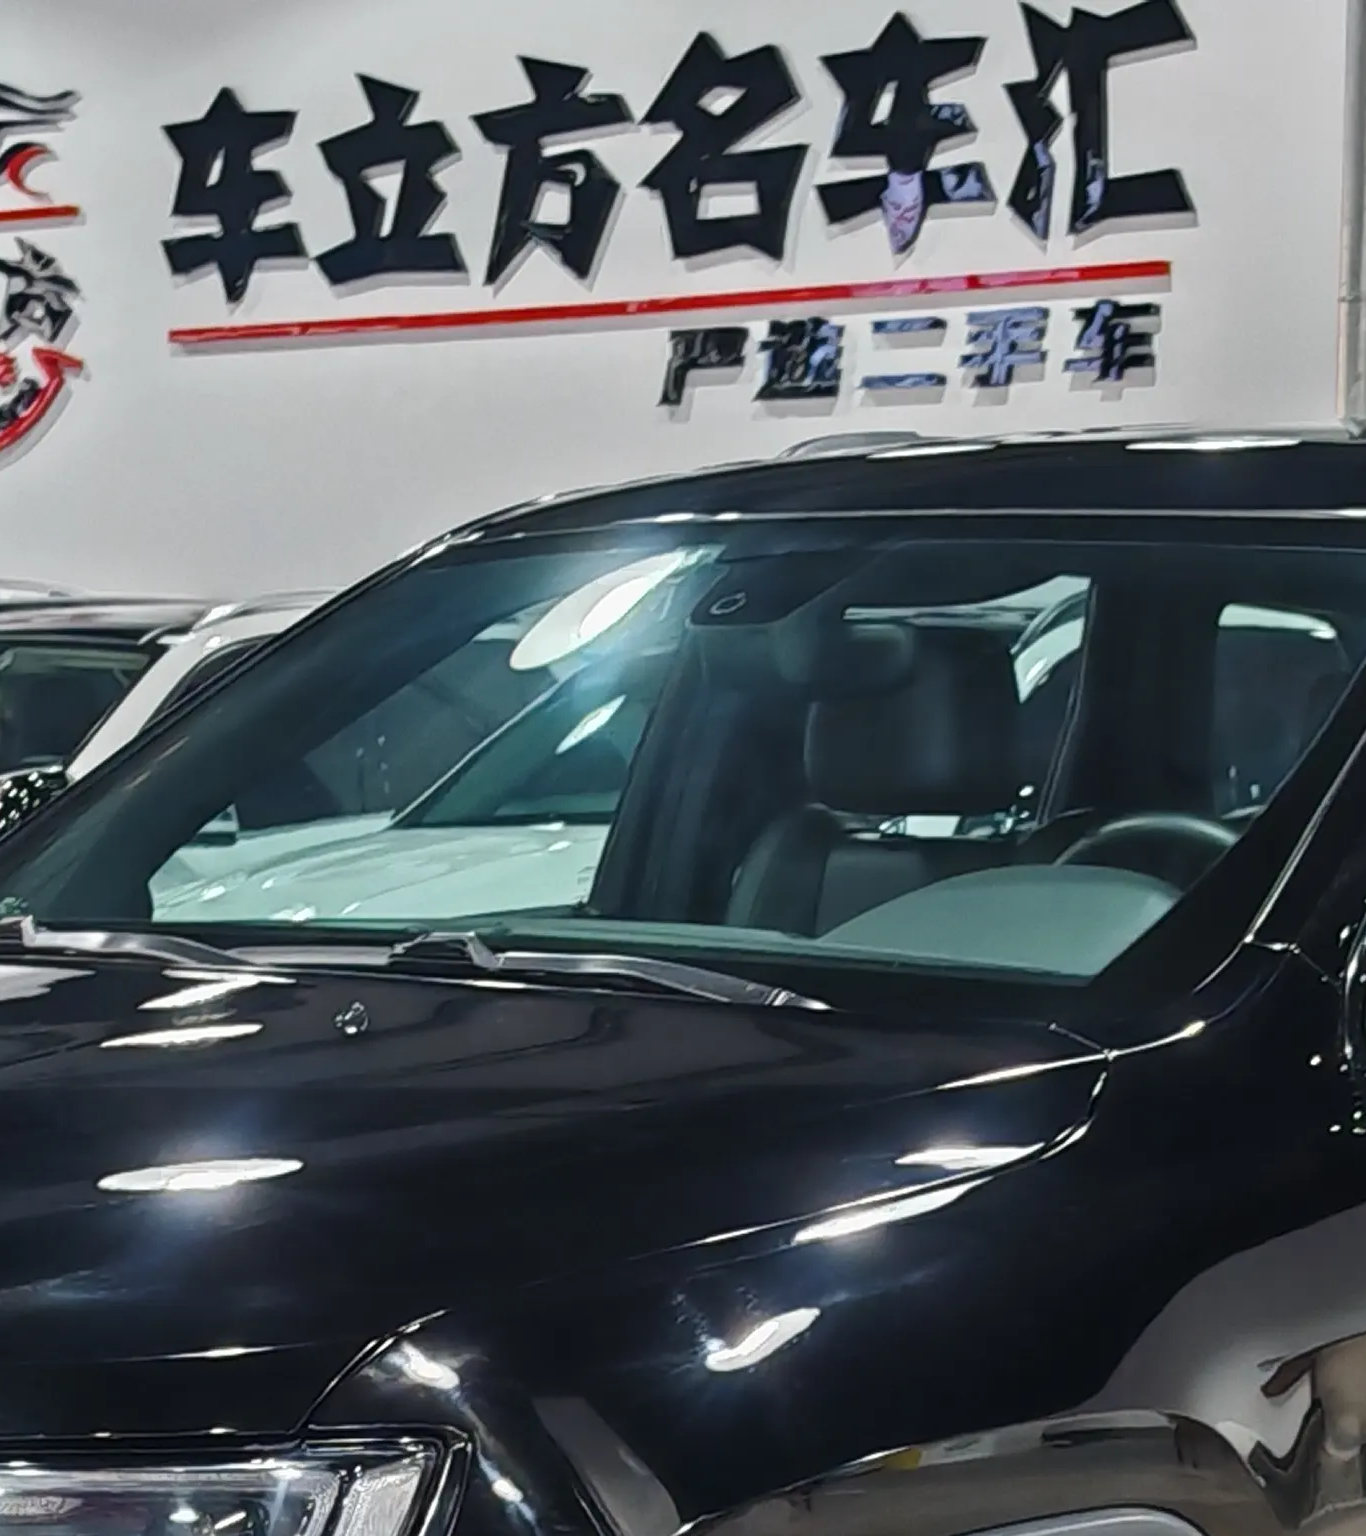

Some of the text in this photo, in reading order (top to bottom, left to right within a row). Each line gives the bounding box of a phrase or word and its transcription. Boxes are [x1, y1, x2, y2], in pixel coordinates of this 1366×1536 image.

[160, 0, 1197, 306] 车立方名车汇
[657, 298, 1163, 408] 严选二手车
